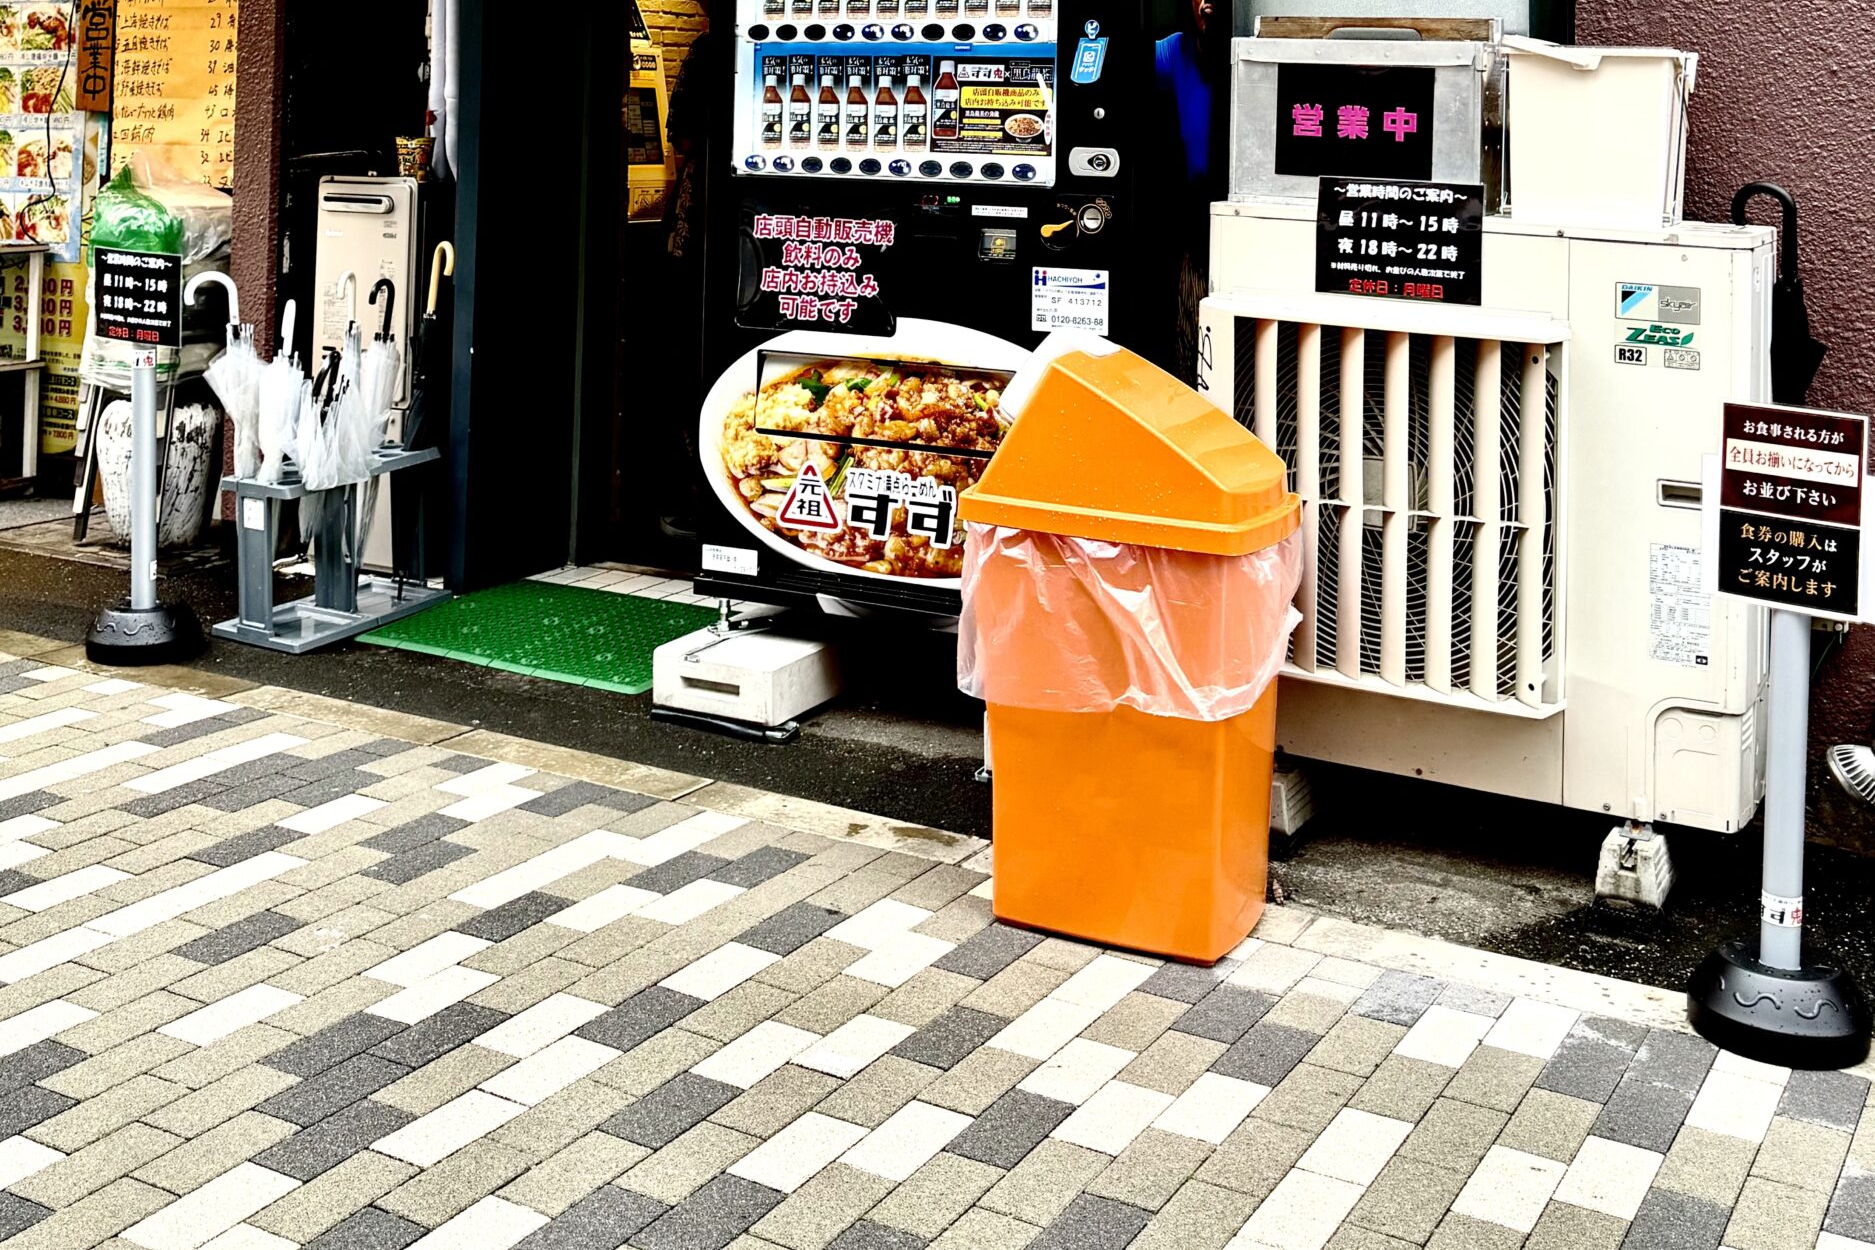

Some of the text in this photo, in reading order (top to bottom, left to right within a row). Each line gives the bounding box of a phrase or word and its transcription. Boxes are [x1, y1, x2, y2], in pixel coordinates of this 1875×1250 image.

[1292, 103, 1418, 142] 営業中
[753, 214, 896, 246] 店頭自動販売機
[782, 242, 862, 269] 飲料のみ
[760, 267, 880, 299] 店内お持込み
[1621, 284, 1653, 292] DAIKIN
[779, 294, 857, 323] 可能です
[1618, 348, 1643, 363] R32
[1743, 420, 1844, 444] お食事される方が
[1729, 446, 1855, 478] 全員お揃いになってから
[796, 478, 823, 517] 元祖
[1743, 480, 1836, 506] お並び下さい
[848, 489, 953, 544] すず
[1740, 523, 1837, 553] 食券の購入は
[1748, 547, 1826, 573] スタッフが
[1738, 568, 1837, 598] ご案内します
